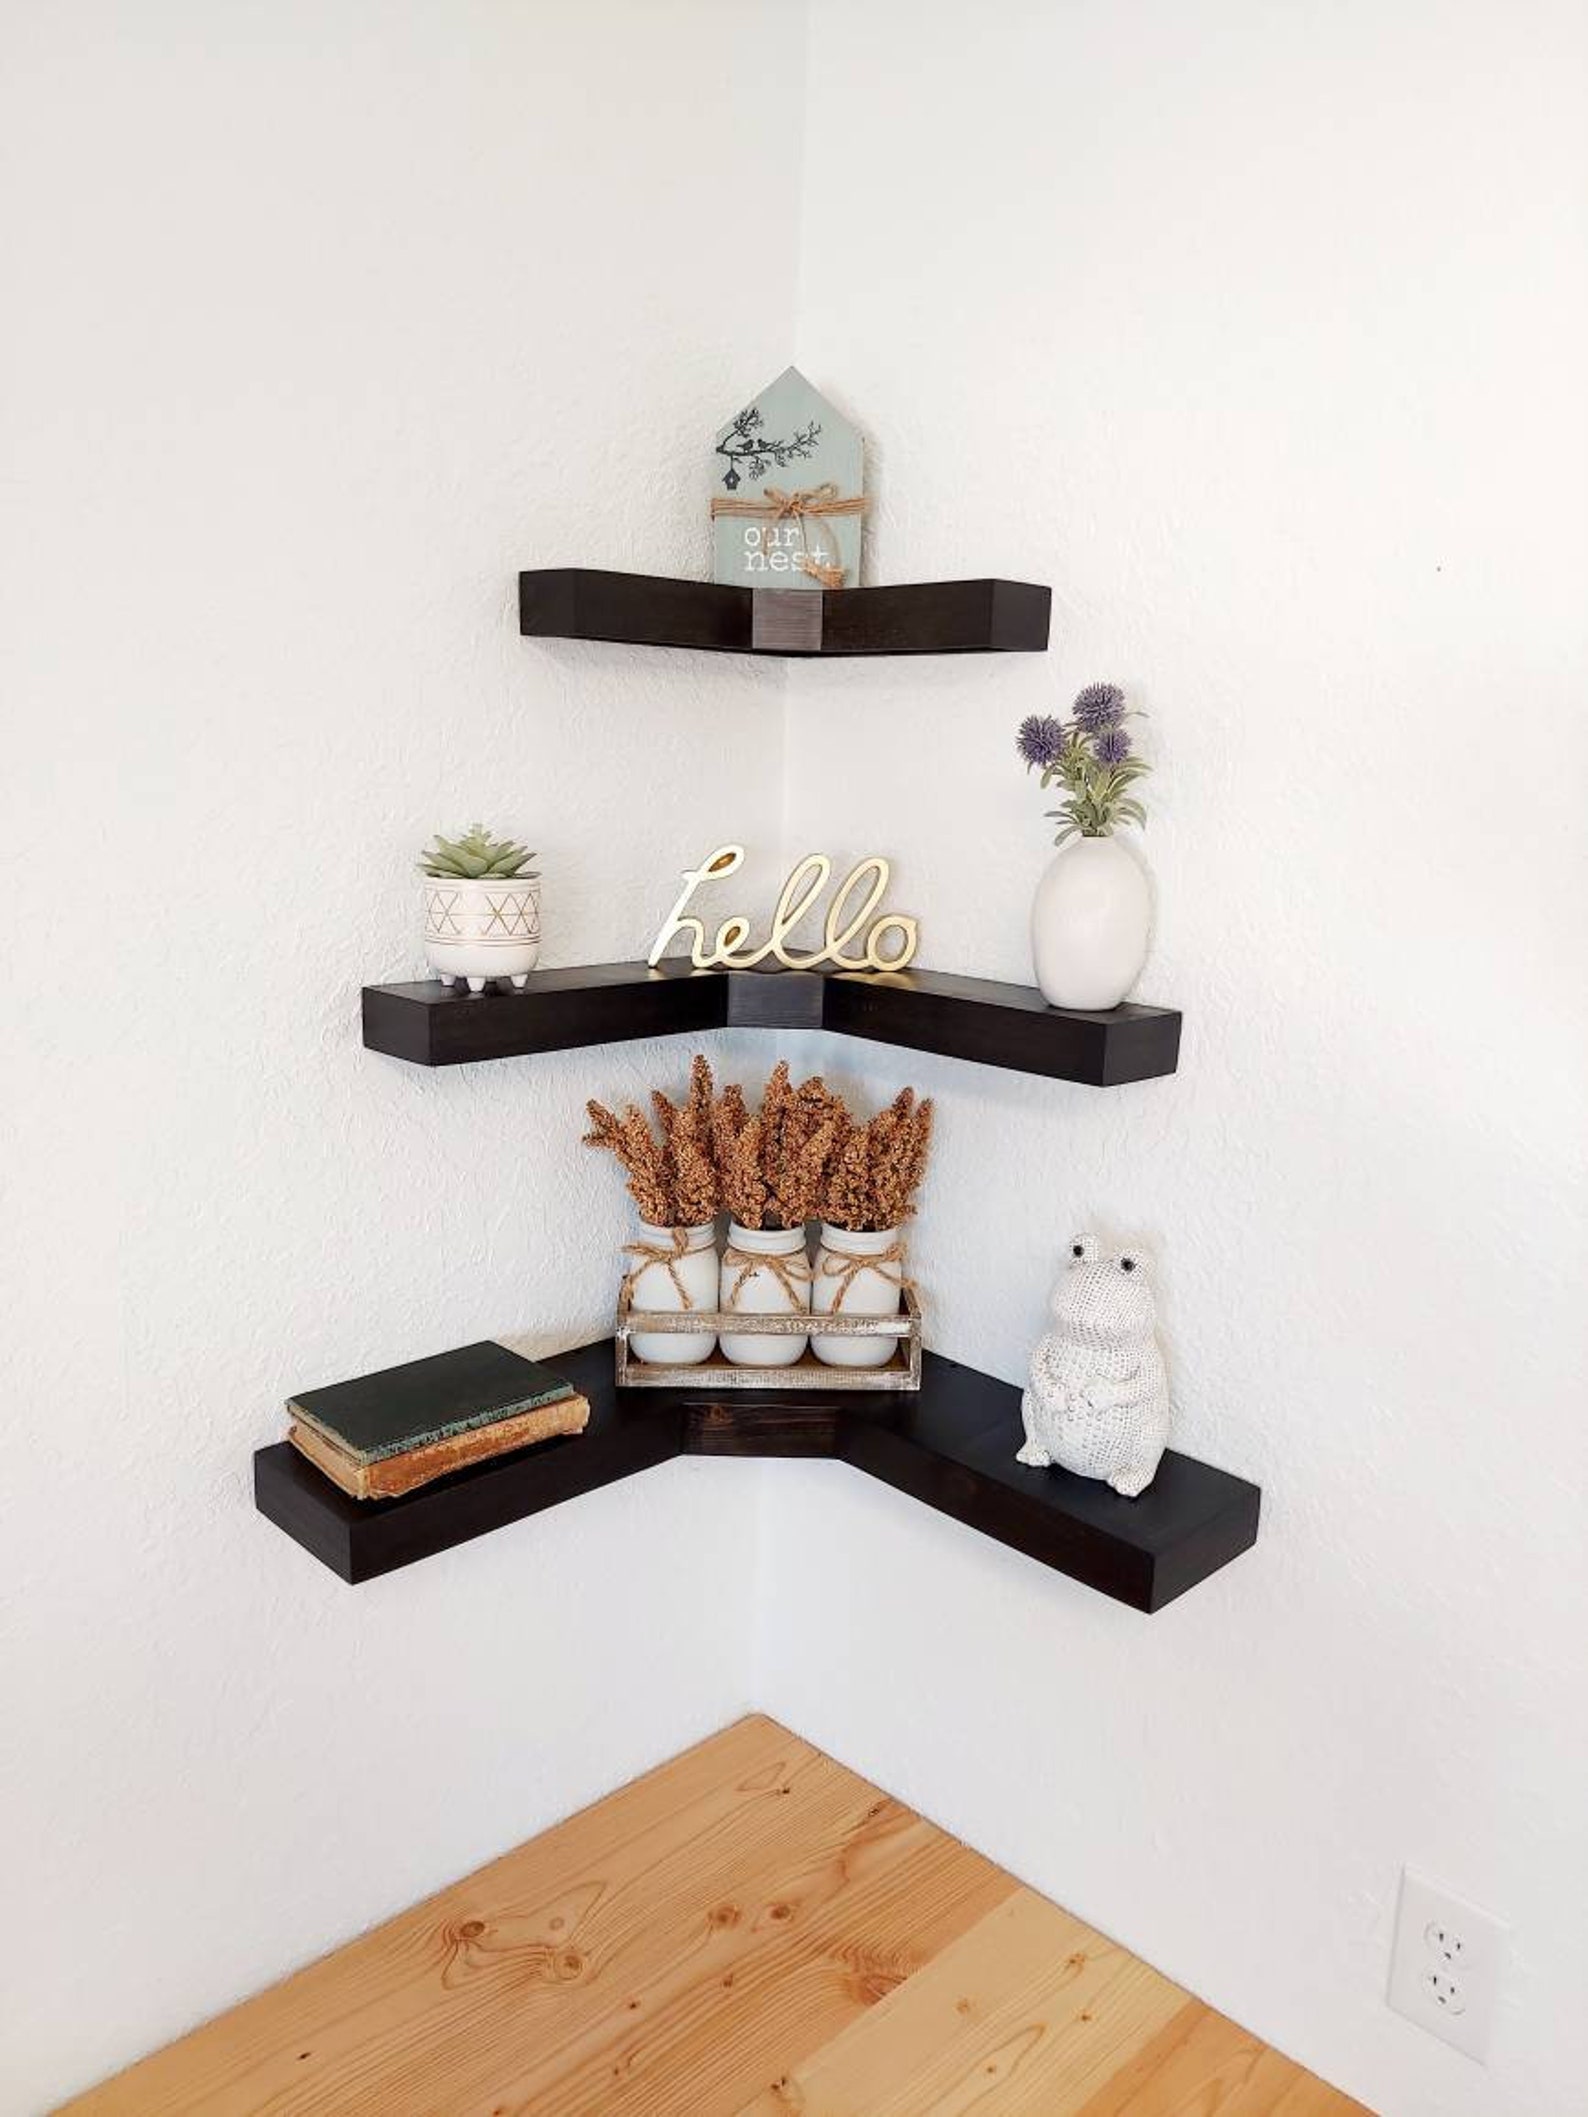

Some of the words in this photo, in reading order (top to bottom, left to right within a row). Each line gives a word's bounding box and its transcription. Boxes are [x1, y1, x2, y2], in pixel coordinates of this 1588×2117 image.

[744, 526, 800, 547] our
[744, 544, 829, 572] nest
[648, 844, 918, 971] hello
